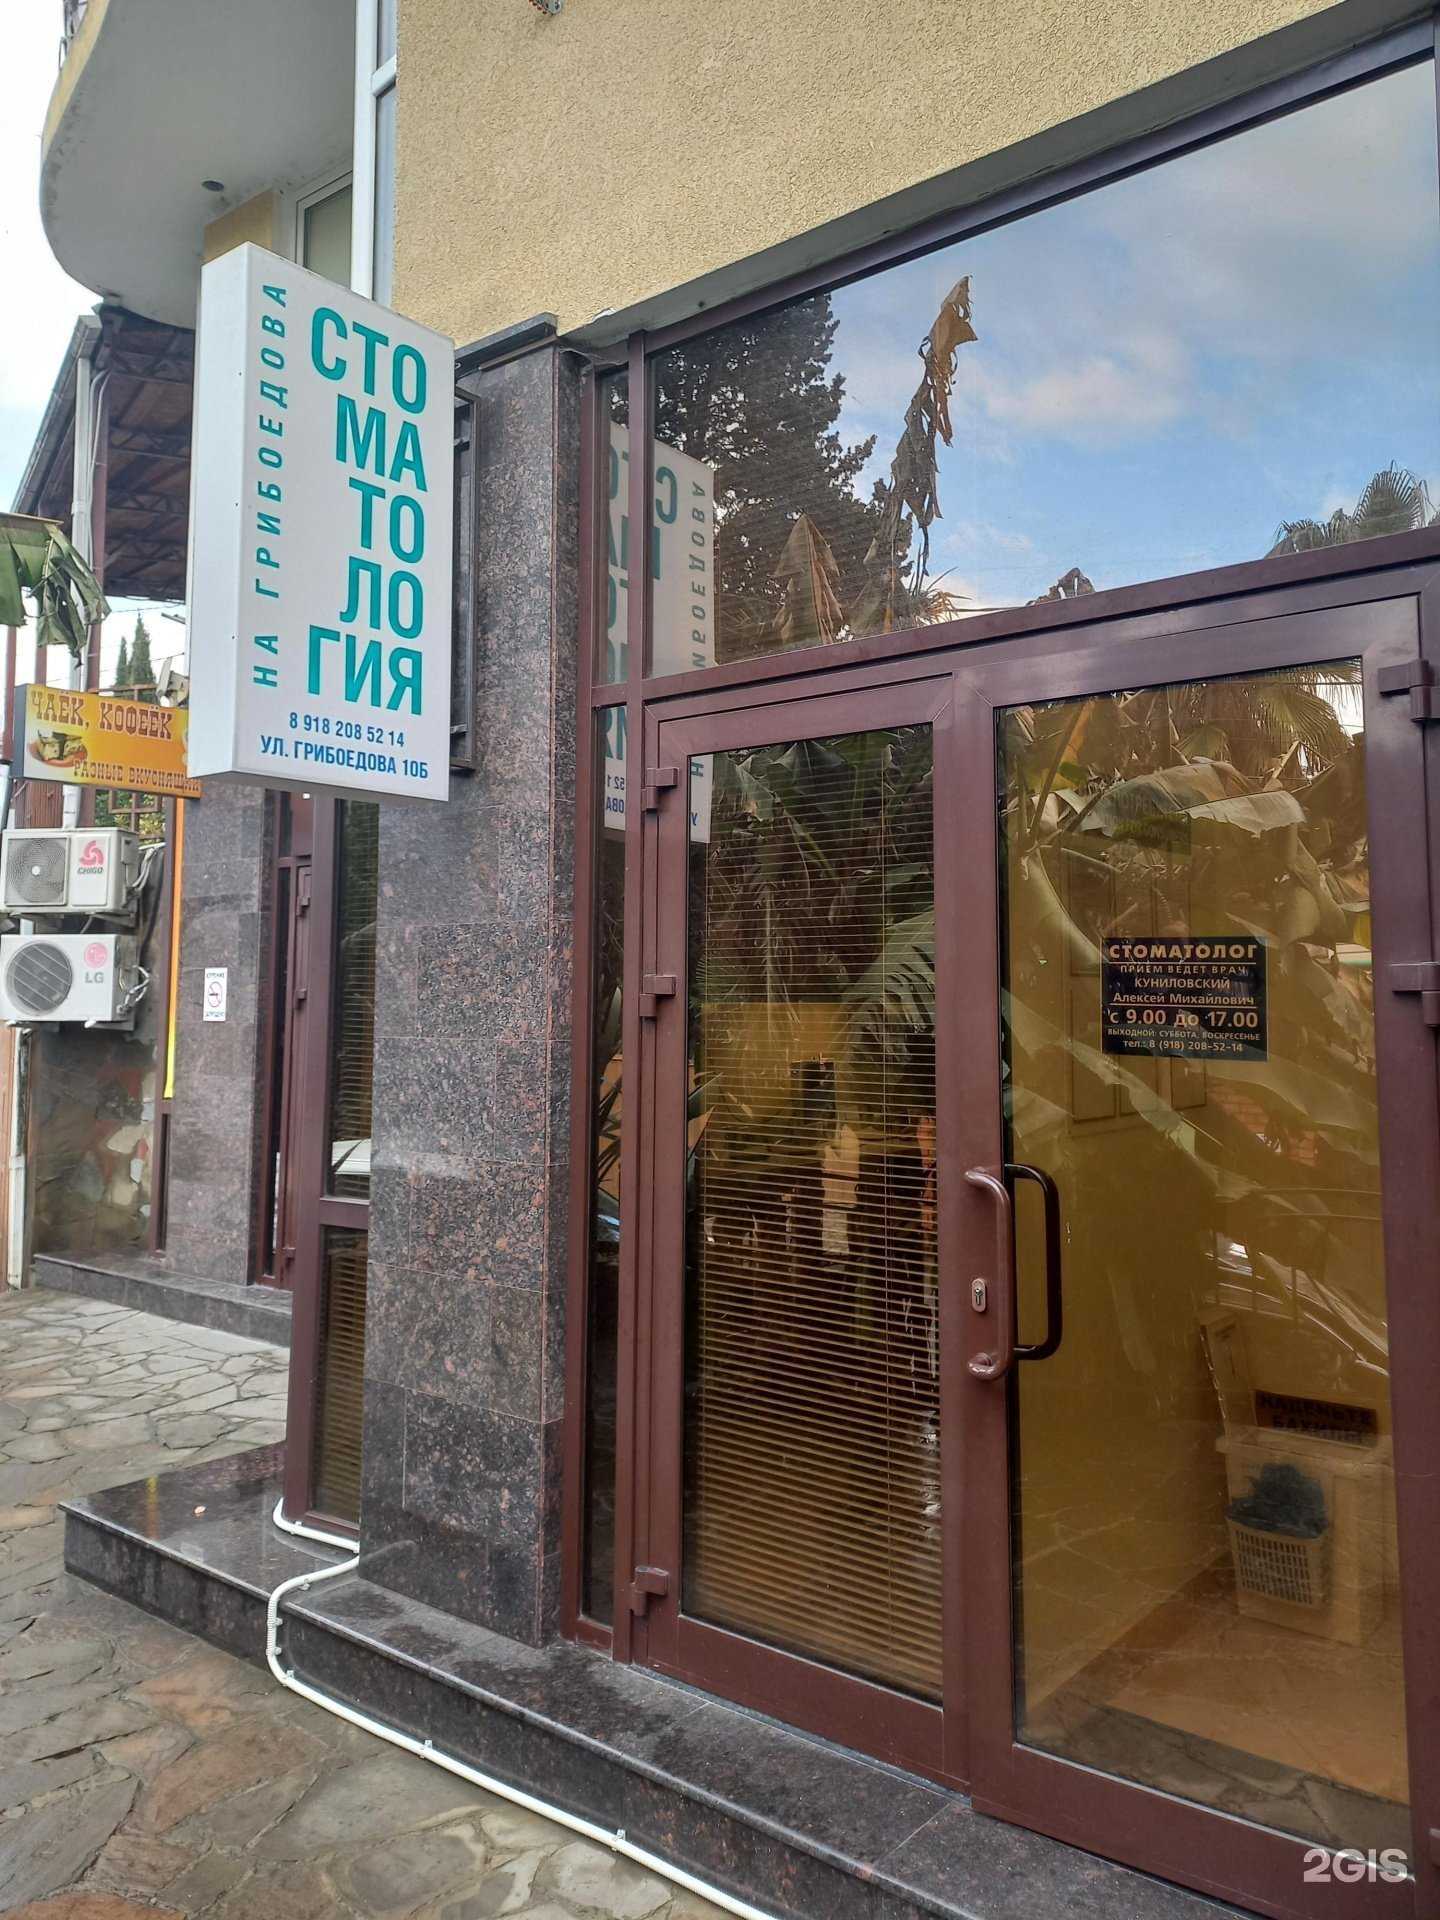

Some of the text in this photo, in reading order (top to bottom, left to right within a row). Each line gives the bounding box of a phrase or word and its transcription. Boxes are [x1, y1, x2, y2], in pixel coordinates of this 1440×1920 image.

[311, 307, 427, 415] СТО
[336, 393, 428, 492] МА
[252, 284, 288, 687] НА ГРИБОЕДОВА
[349, 476, 425, 564] ТО
[339, 556, 424, 640] ЛО
[308, 624, 423, 716] ГИЯ
[100, 702, 173, 740] КОФЕЁК
[289, 712, 405, 747] 8 918 208 52 14
[74, 760, 123, 781] РАЗНЫЕ
[260, 735, 428, 779] УЛ. ГРИБОЕДОВА 10Б
[1109, 944, 1258, 959] СТОМАТОЛОГ
[84, 972, 104, 983] LG
[1135, 976, 1231, 989] КУНИЛОВСКИЙ
[1113, 992, 1255, 1006] Алексей Михайлович
[1126, 1009, 1167, 1025] 9.00
[1174, 1013, 1199, 1028] до
[1207, 1011, 1258, 1028] 17.00
[1159, 1040, 1185, 1051] (918)
